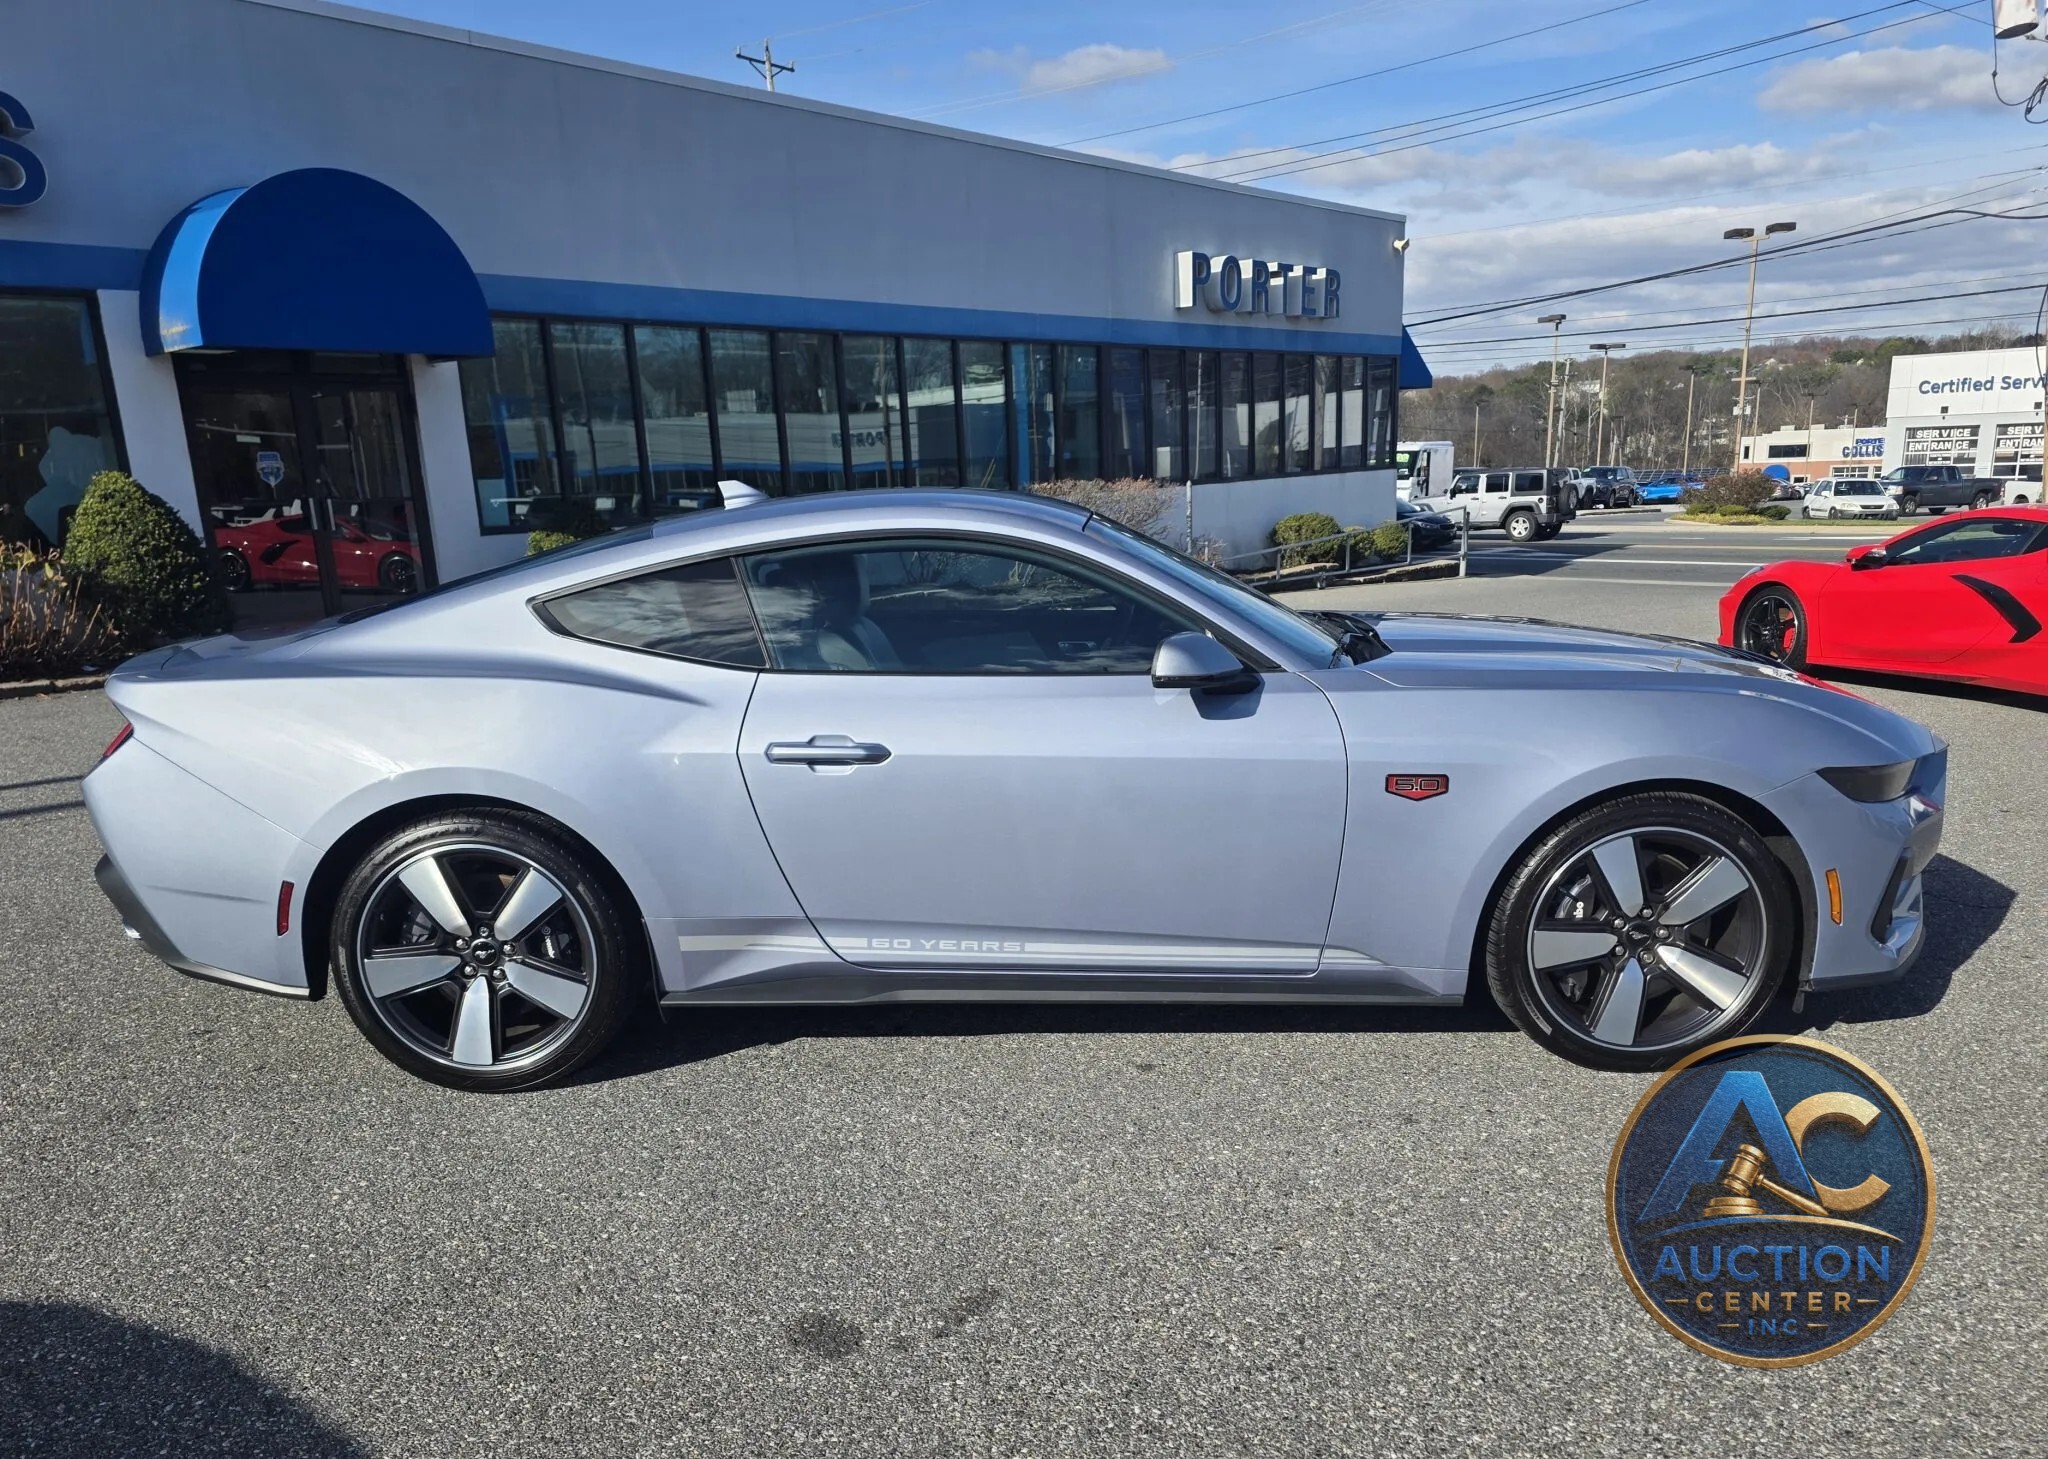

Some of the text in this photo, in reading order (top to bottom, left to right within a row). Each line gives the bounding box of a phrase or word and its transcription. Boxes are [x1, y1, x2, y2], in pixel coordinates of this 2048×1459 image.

[1189, 251, 1341, 318] PORTER
[1919, 376, 1995, 394] Certified
[1916, 428, 1972, 439] SERVICE
[2007, 425, 2043, 435] SERV
[1855, 437, 1885, 445] PORTE
[1908, 441, 1970, 451] ENTRANCE
[1999, 438, 2044, 448] ENTRAN
[1842, 445, 1885, 458] COLLIS
[1395, 778, 1440, 791] 5.0
[871, 938, 1021, 952] 60 YEARS
